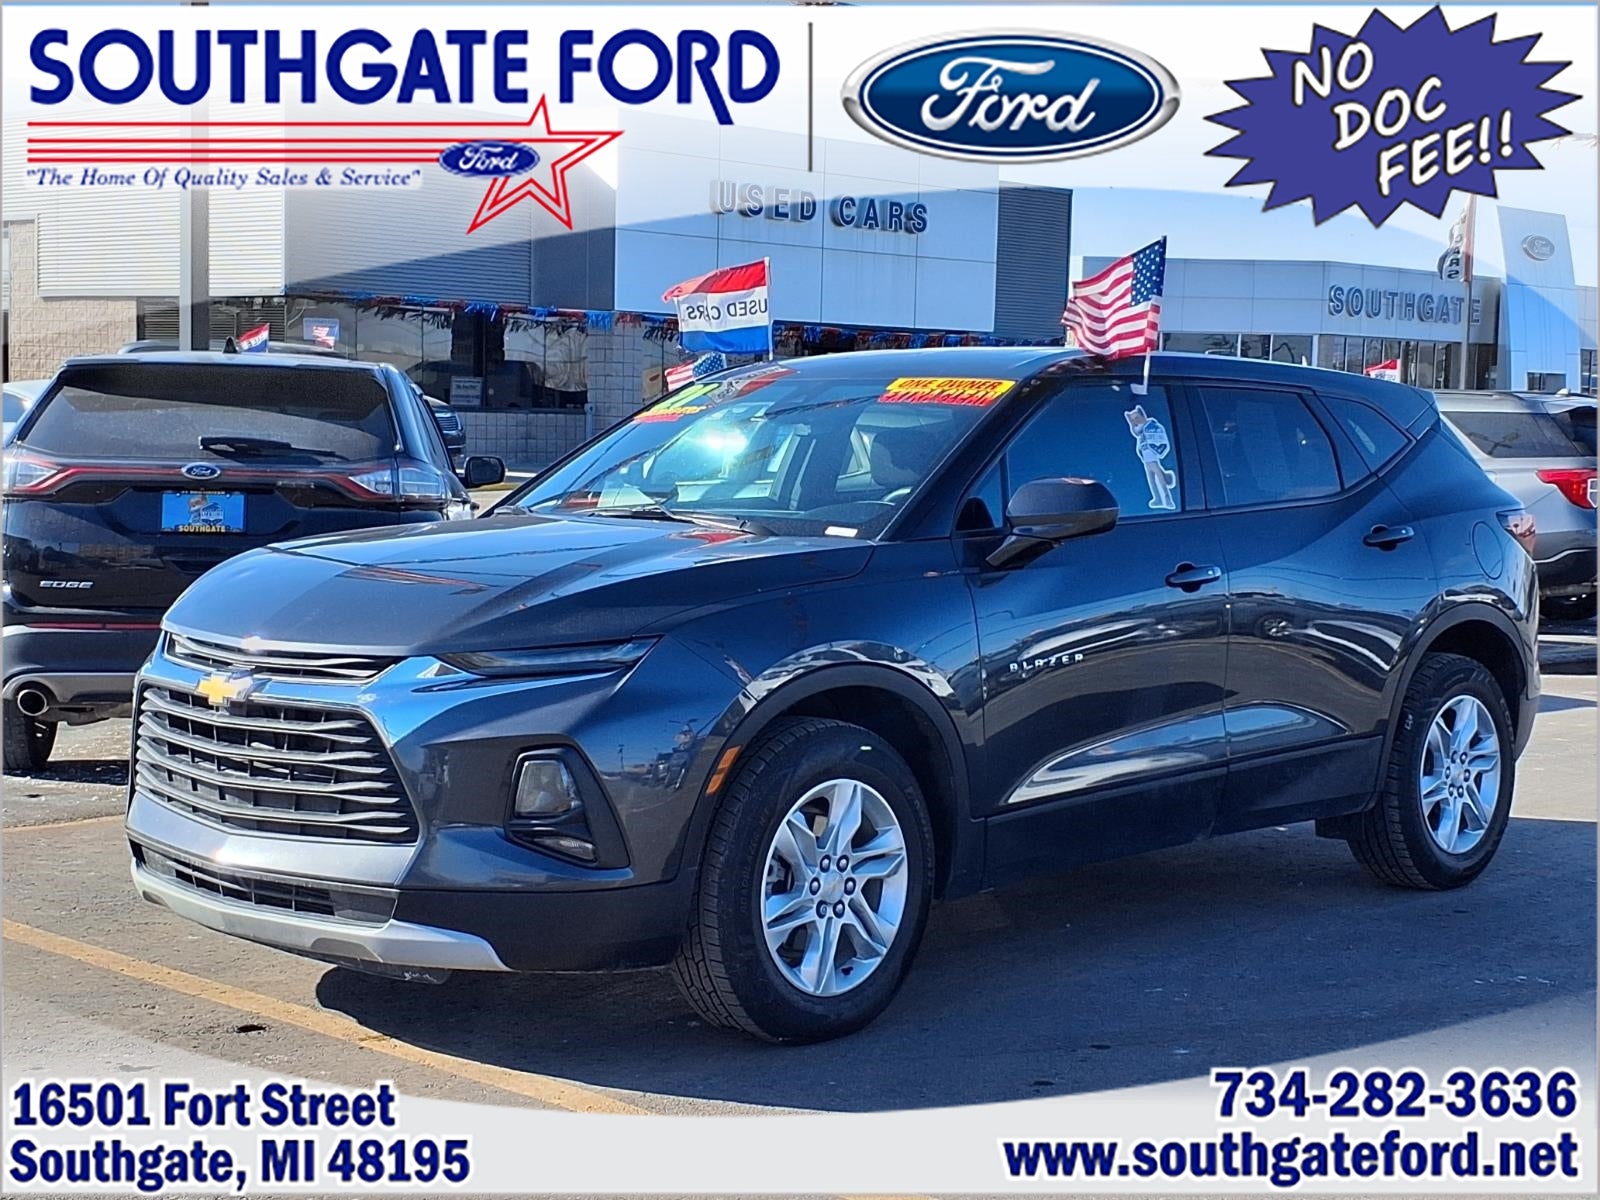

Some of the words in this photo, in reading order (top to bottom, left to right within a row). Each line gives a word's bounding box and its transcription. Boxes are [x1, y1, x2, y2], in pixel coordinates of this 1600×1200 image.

[709, 180, 817, 222] USED
[830, 195, 929, 234] CARS
[1328, 284, 1481, 325] SOUTHGATE
[898, 379, 937, 389] ONE
[938, 379, 1003, 391] OWNER
[178, 525, 226, 534] SOUTHGATE
[40, 580, 94, 589] EDGE
[1009, 653, 1084, 673] BLAZER
